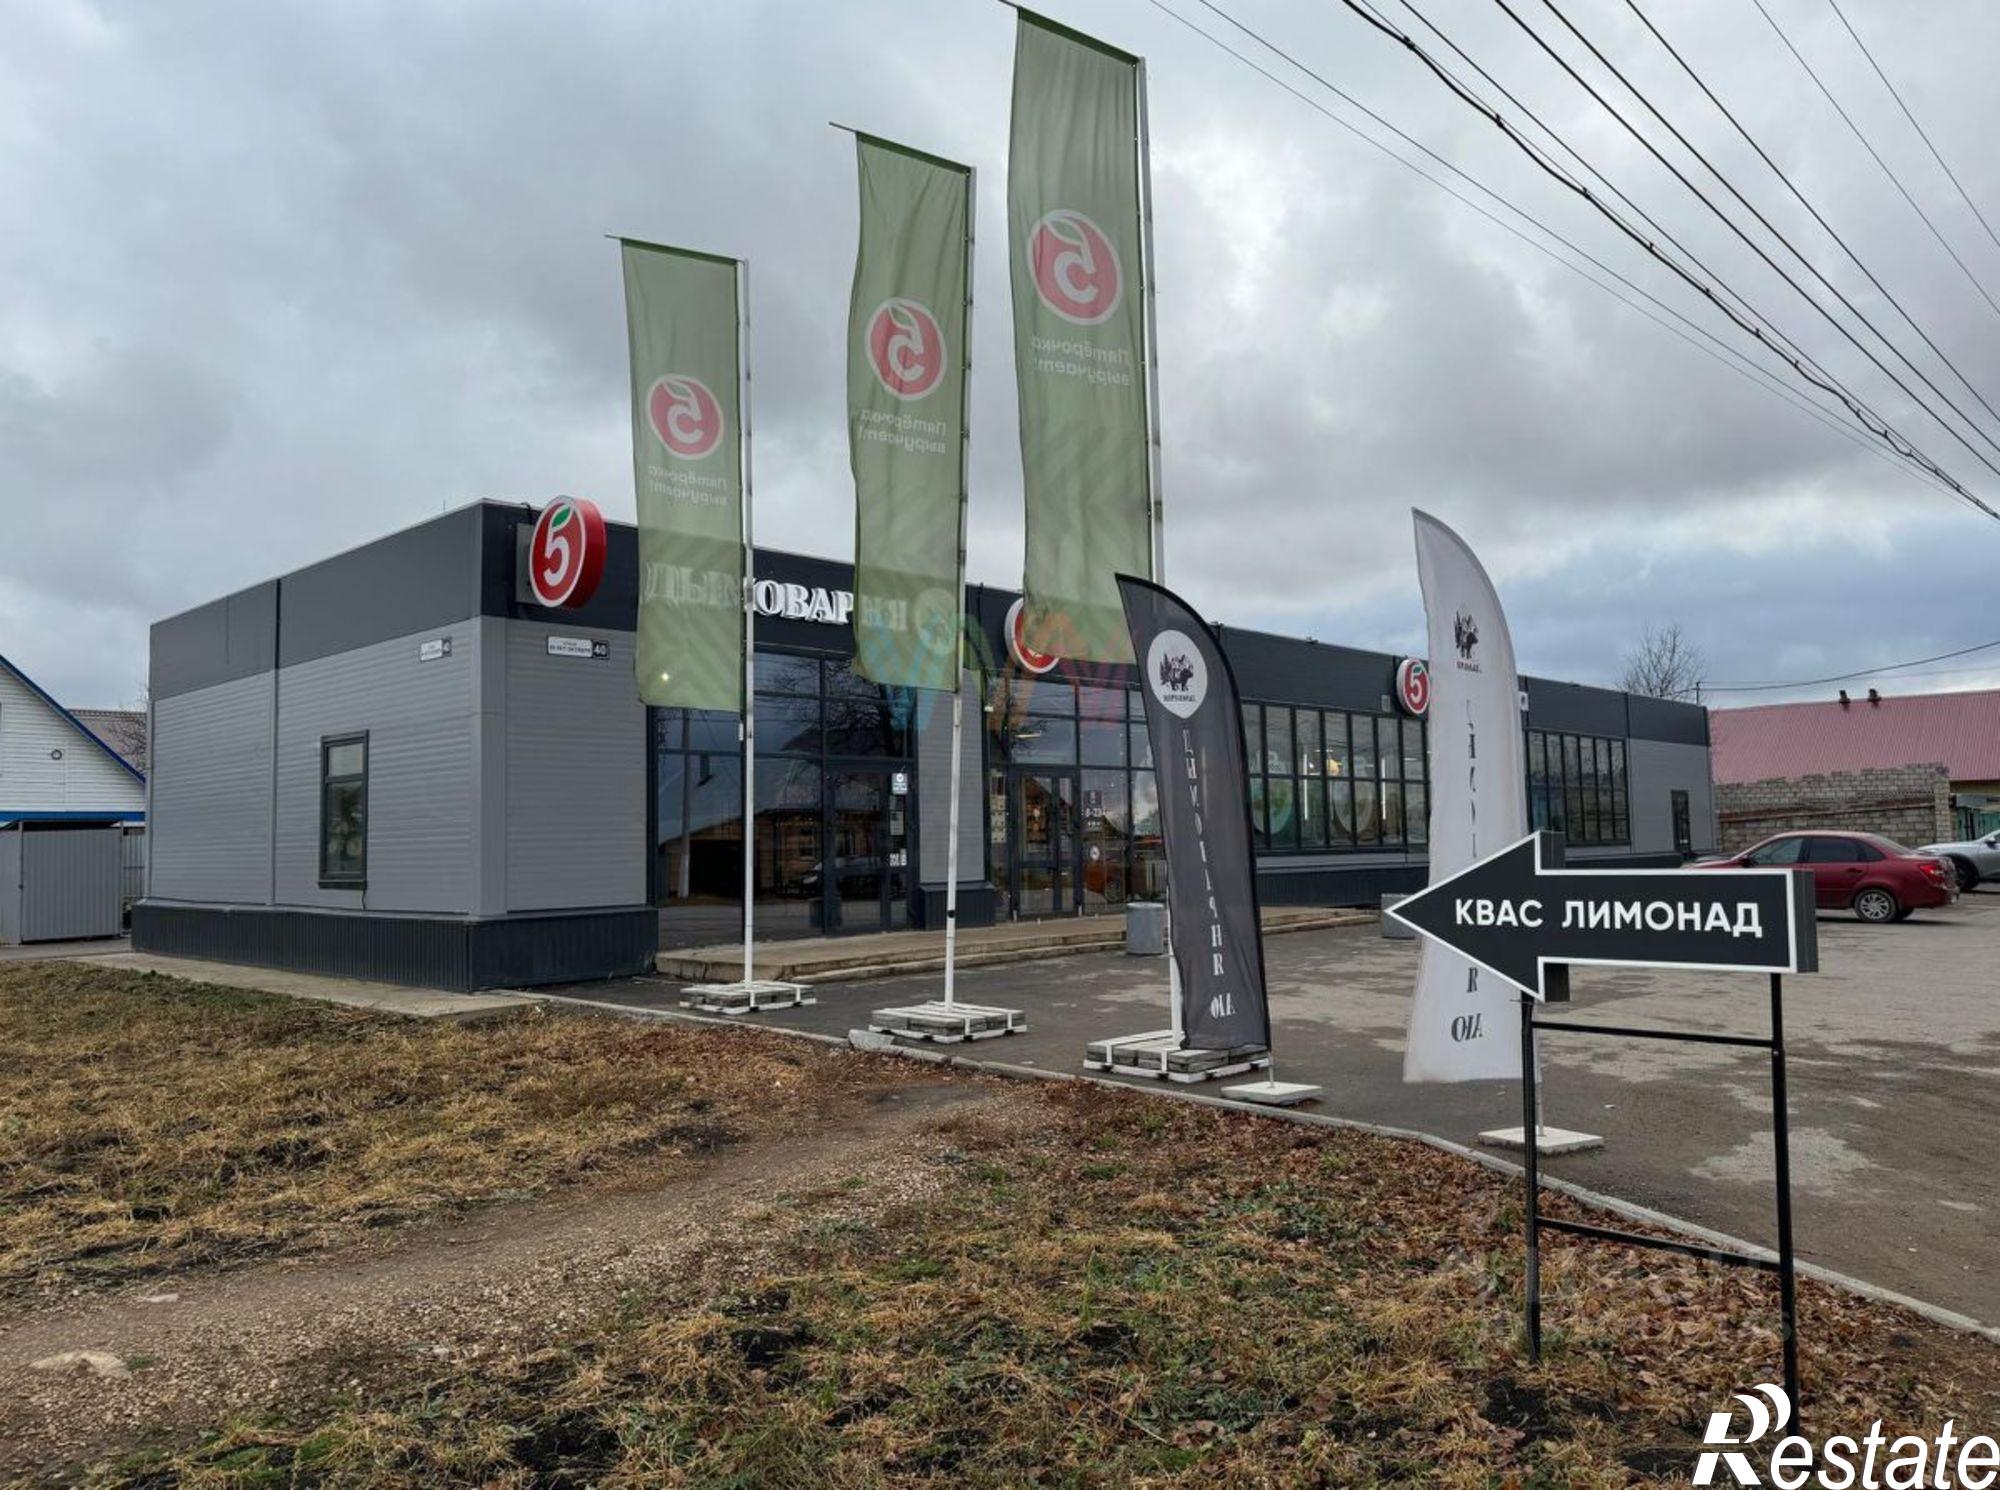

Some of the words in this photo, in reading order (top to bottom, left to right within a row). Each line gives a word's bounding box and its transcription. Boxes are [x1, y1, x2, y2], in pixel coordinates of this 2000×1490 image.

[542, 506, 572, 586] 5
[1455, 898, 1544, 928] КВАС
[1561, 900, 1763, 939] ЛИМОНАД
